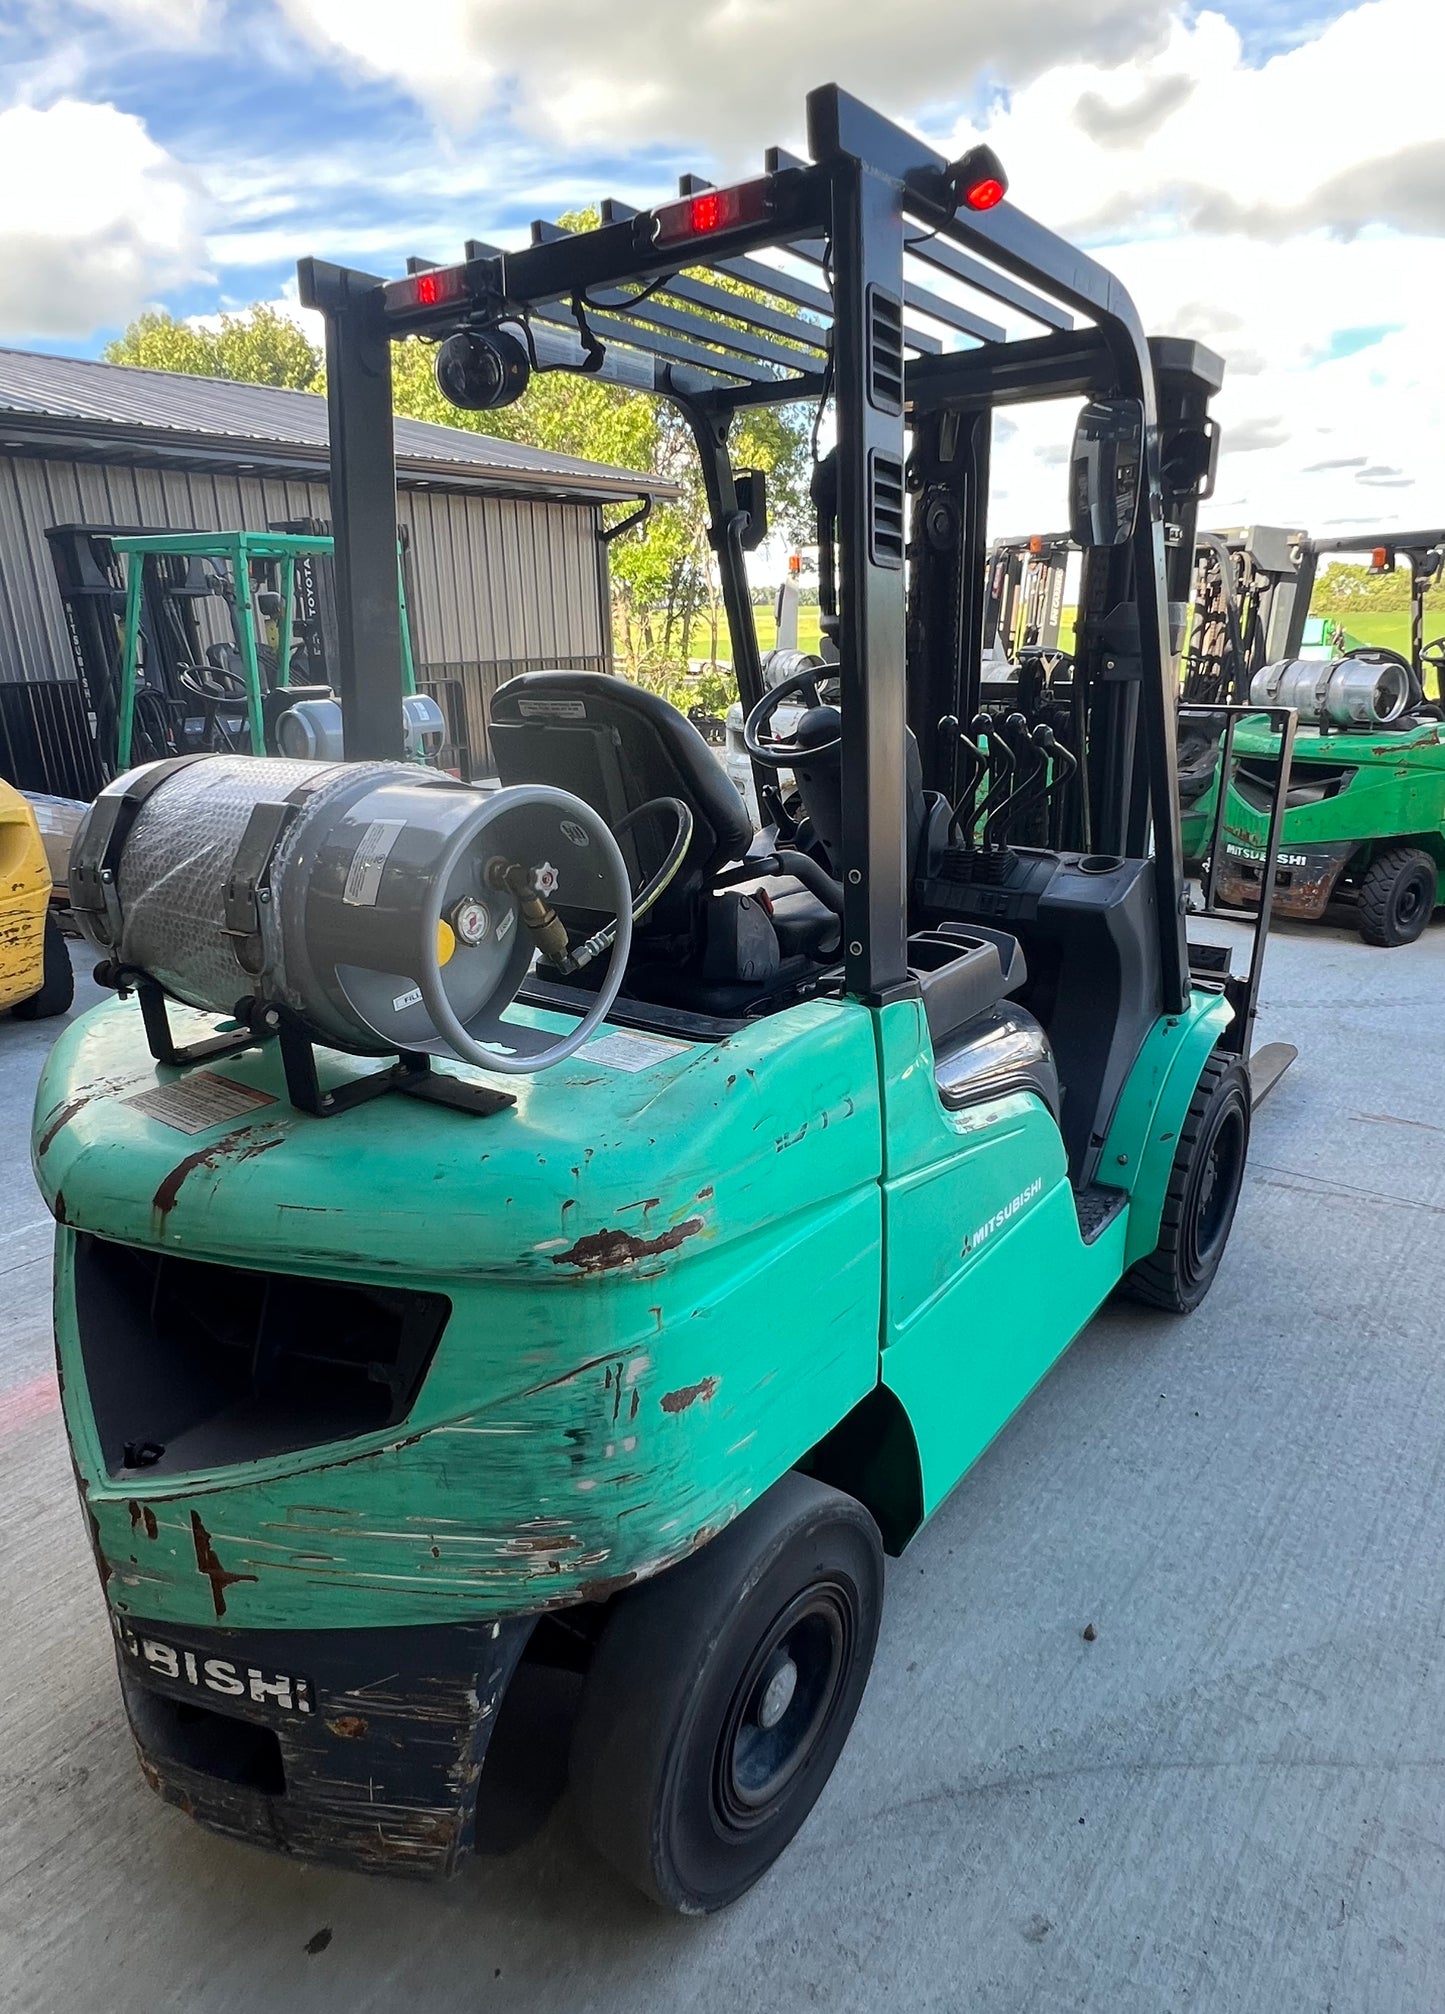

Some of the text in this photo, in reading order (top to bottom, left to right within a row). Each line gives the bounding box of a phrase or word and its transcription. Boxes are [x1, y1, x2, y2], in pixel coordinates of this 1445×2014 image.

[303, 558, 316, 617] TOYOTA
[66, 603, 92, 708] MITSUBISHI
[1226, 843, 1307, 866] MITSUBSHI
[973, 1177, 1042, 1248] MITSUBISHI
